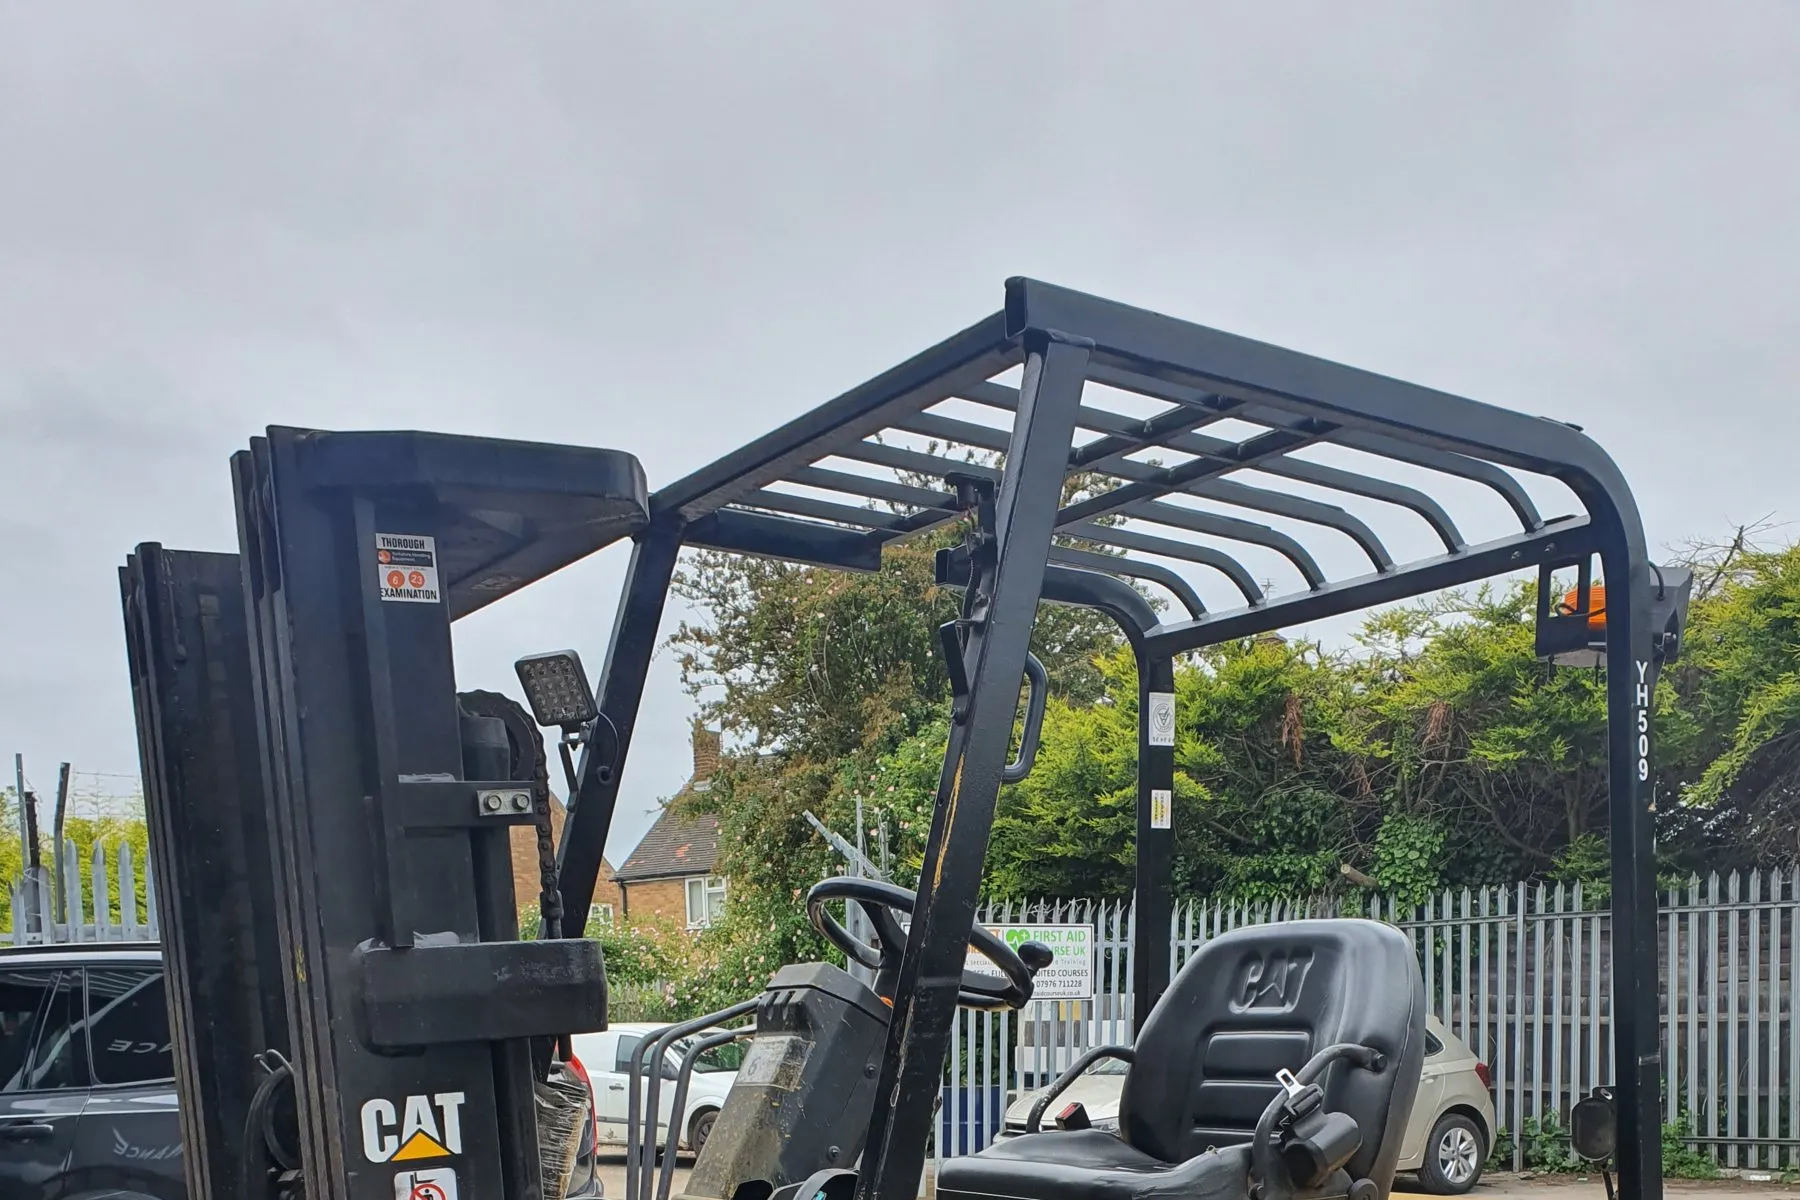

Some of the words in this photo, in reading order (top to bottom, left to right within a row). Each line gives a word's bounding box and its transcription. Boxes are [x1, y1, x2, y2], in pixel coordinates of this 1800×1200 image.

[381, 537, 425, 549] THOROUGH
[392, 576, 398, 585] 6
[410, 574, 423, 585] 23
[380, 588, 437, 600] EXAMINATION
[1635, 660, 1649, 782] YH509
[1033, 930, 1063, 942] FIRST
[1067, 930, 1086, 942] AID
[1073, 946, 1086, 956] UK
[1057, 969, 1089, 977] COURSES
[1036, 980, 1057, 988] 07976
[1059, 980, 1083, 988] 711228
[360, 1091, 466, 1164] CAT
